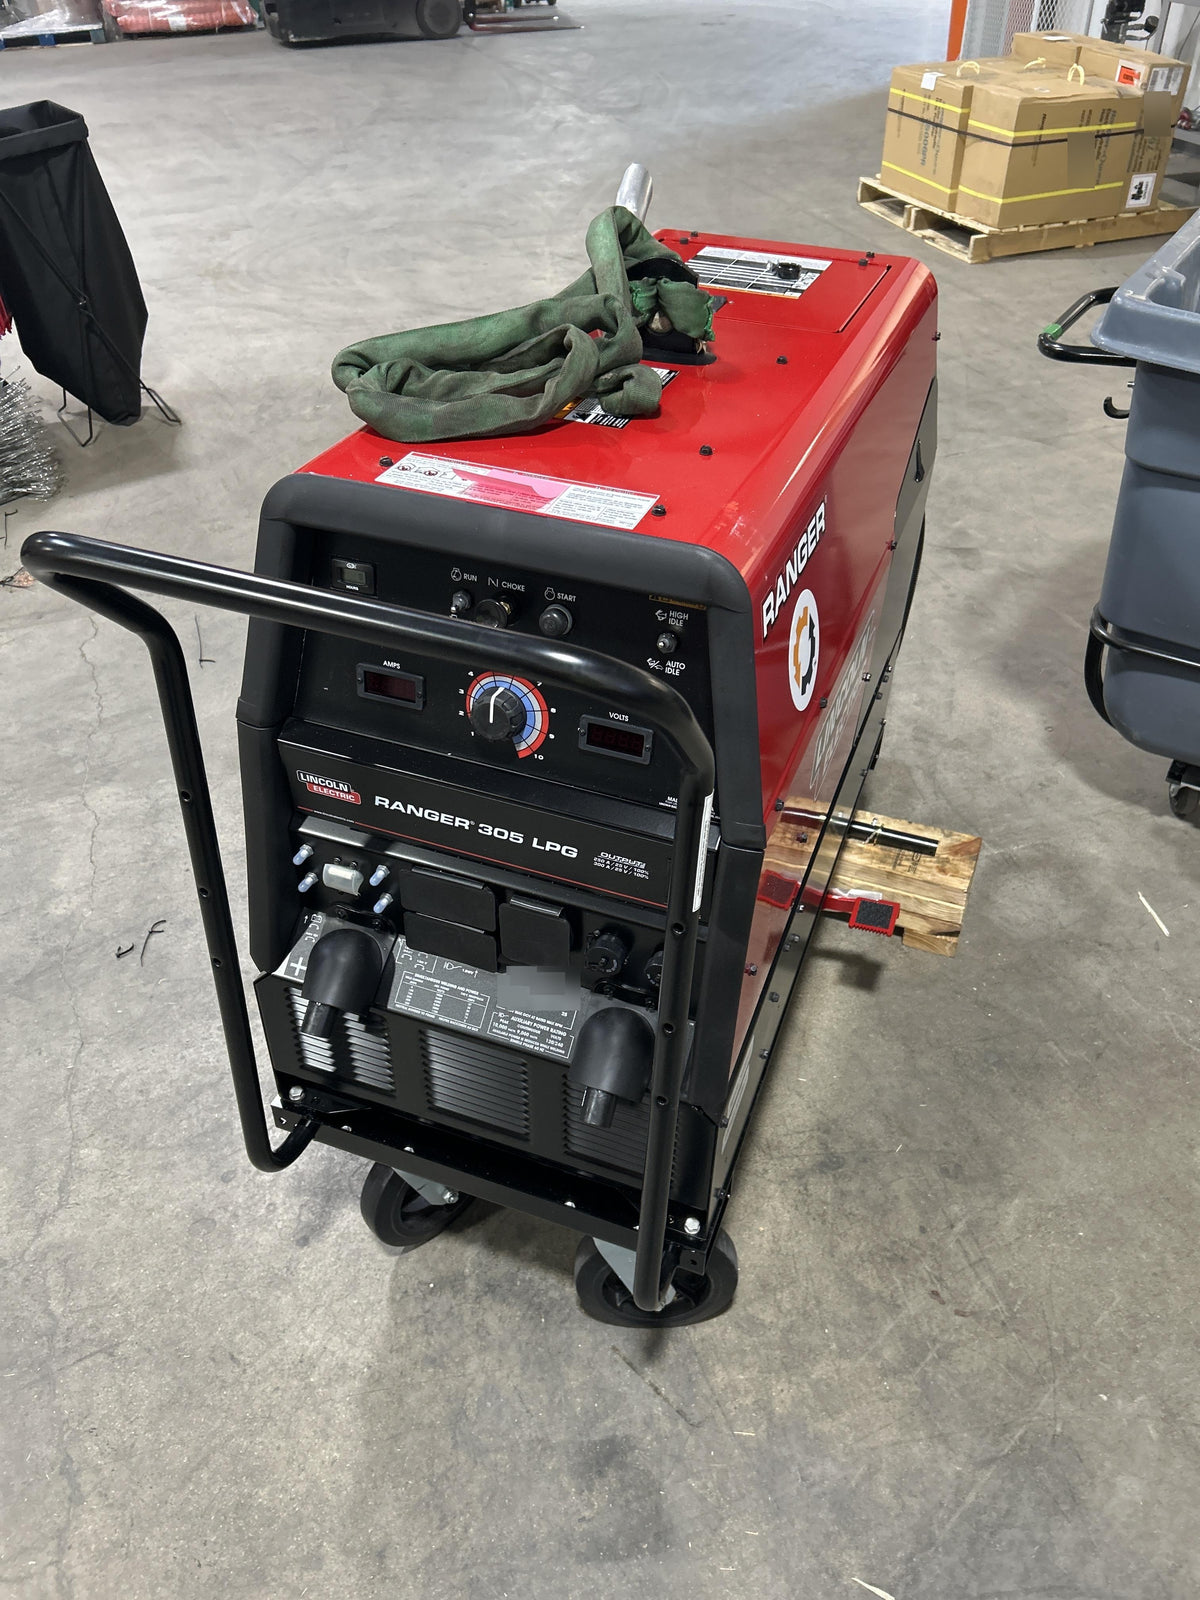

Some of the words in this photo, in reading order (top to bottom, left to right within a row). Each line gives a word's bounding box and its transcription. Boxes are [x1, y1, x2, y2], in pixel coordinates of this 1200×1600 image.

[762, 501, 826, 640] RANGER
[463, 573, 478, 583] RUN
[501, 581, 526, 592] CHOKE
[557, 592, 577, 603] START
[669, 610, 689, 620] HIGH
[668, 618, 684, 627] IDLE
[382, 660, 401, 670] AMPS
[665, 660, 686, 670] AUTO
[664, 667, 681, 676] IDLE
[608, 711, 629, 722] VOLTS
[300, 772, 349, 793] LINCOLN
[313, 784, 355, 802] ELECTRIC
[477, 823, 524, 844] 305
[531, 837, 579, 859] LPG
